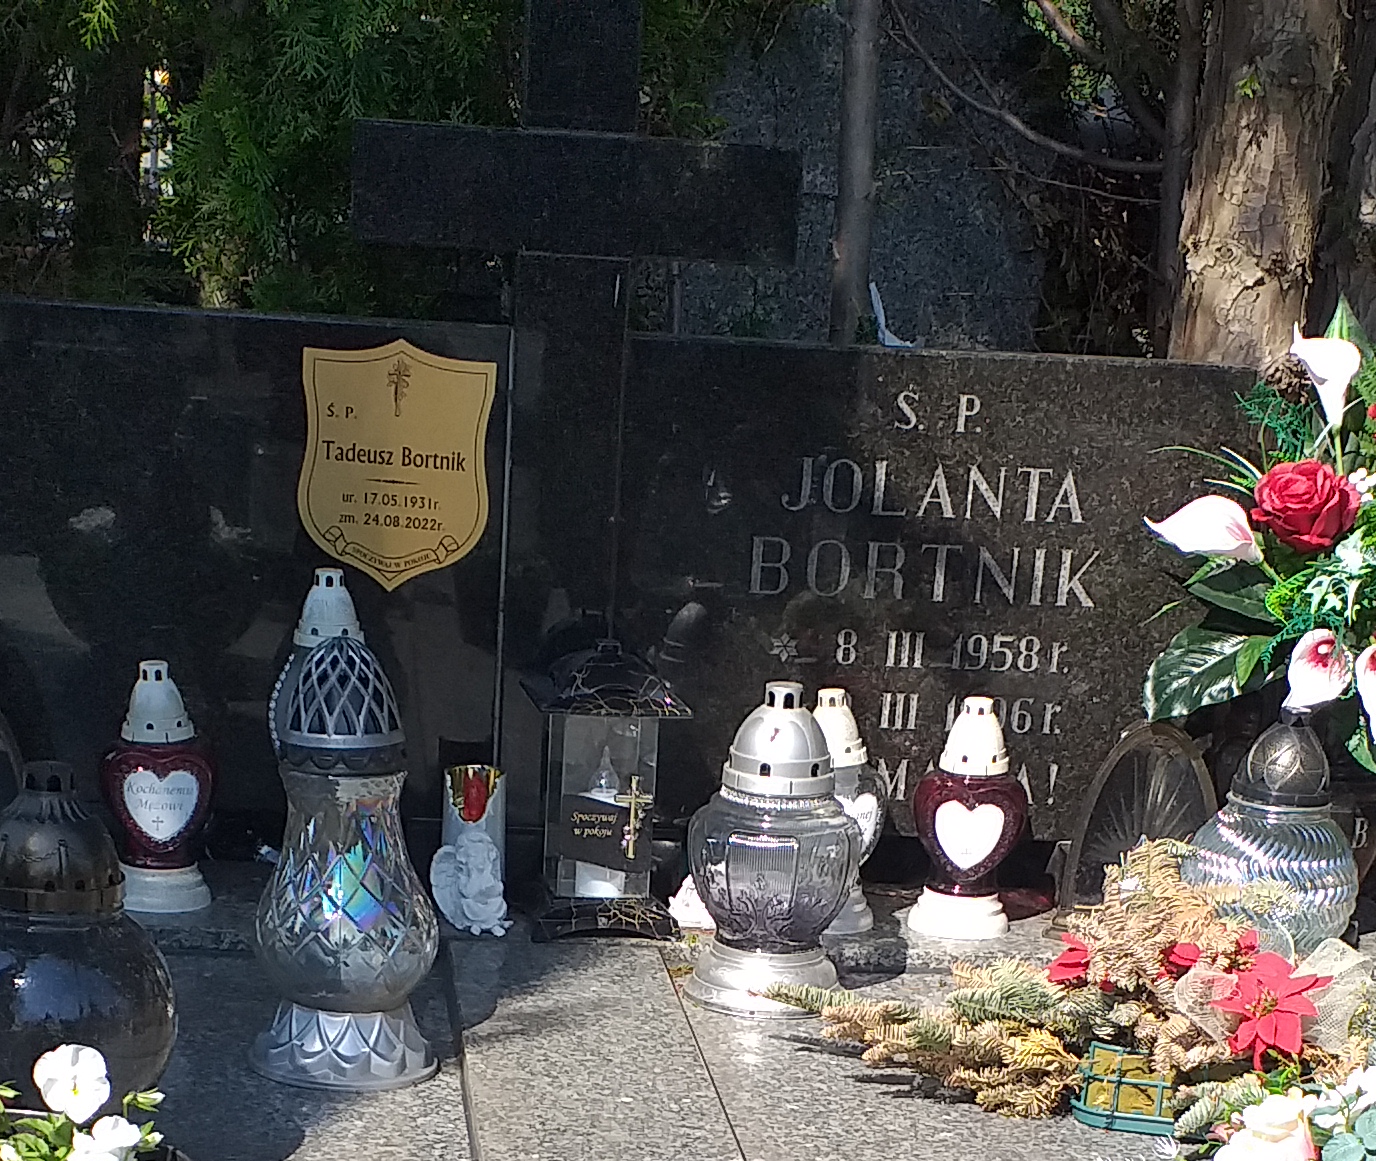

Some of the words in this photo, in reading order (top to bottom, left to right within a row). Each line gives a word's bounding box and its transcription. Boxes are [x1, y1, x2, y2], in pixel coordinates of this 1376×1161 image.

[345, 406, 358, 419] P.
[322, 440, 394, 465] Tadeusz
[401, 447, 466, 472] Bortnik
[342, 493, 357, 504] ur.
[780, 454, 1085, 524] JOLANTA
[339, 514, 359, 525] zm.
[748, 535, 1102, 609] BORTNIK
[835, 628, 858, 665] 8
[885, 630, 925, 669] III
[878, 692, 919, 730] III
